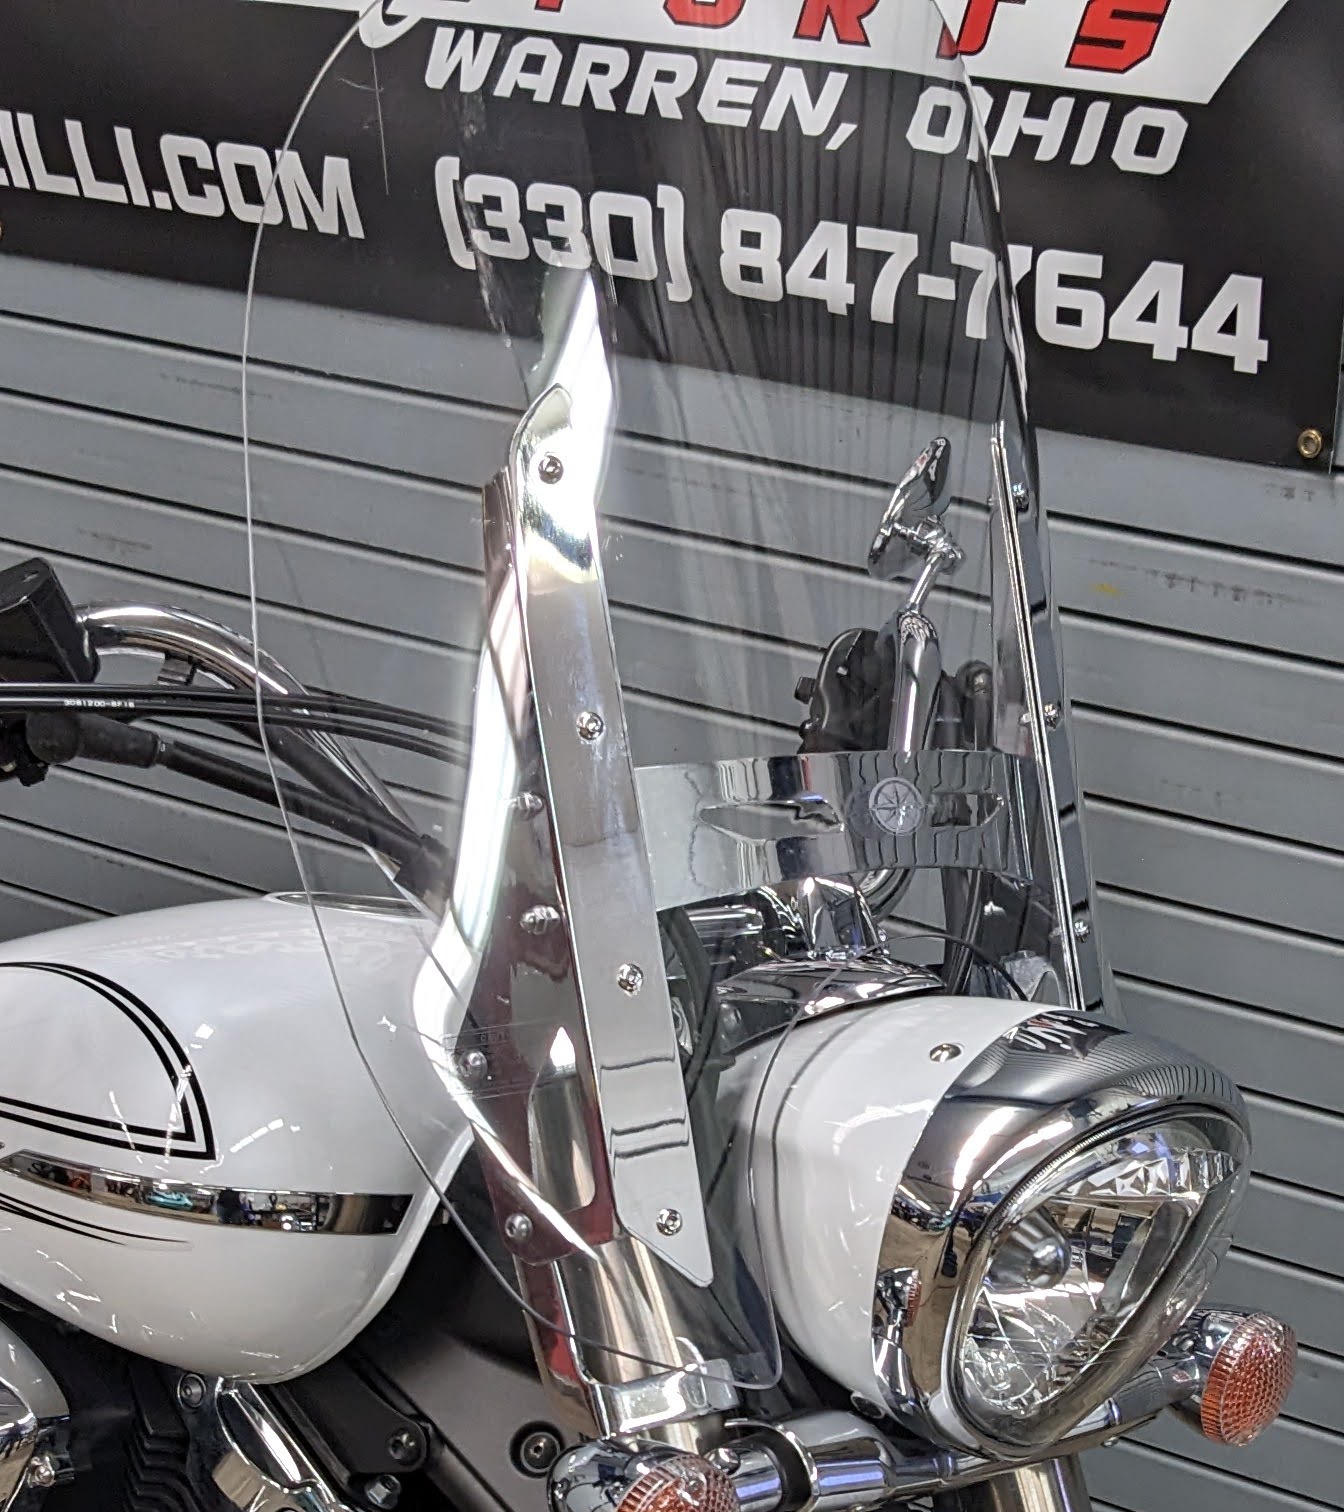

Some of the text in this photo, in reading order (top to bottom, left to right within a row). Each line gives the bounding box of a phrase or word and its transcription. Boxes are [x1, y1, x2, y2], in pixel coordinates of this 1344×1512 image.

[424, 26, 1189, 175] WARREN, OHIO
[434, 155, 1269, 374] (330) 847-7644
